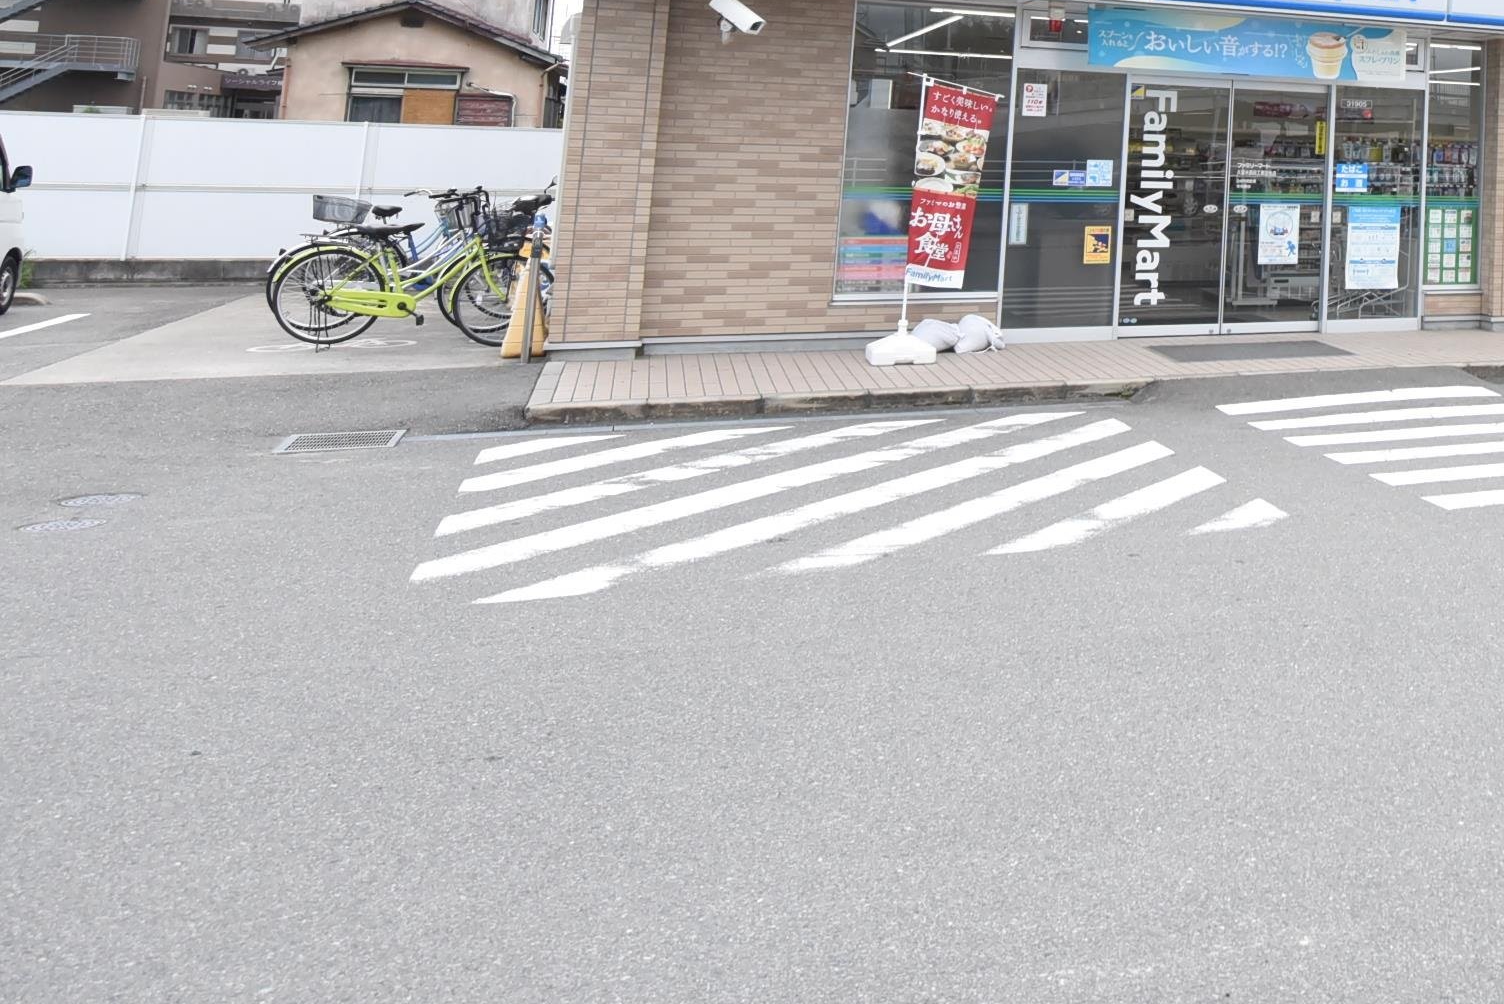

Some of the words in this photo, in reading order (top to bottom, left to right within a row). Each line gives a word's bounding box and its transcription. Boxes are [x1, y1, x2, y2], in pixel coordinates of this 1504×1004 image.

[1341, 164, 1364, 173] たばこ
[1130, 89, 1178, 306] FamilyMart
[909, 206, 963, 239] お母さん
[914, 231, 950, 261] 食堂
